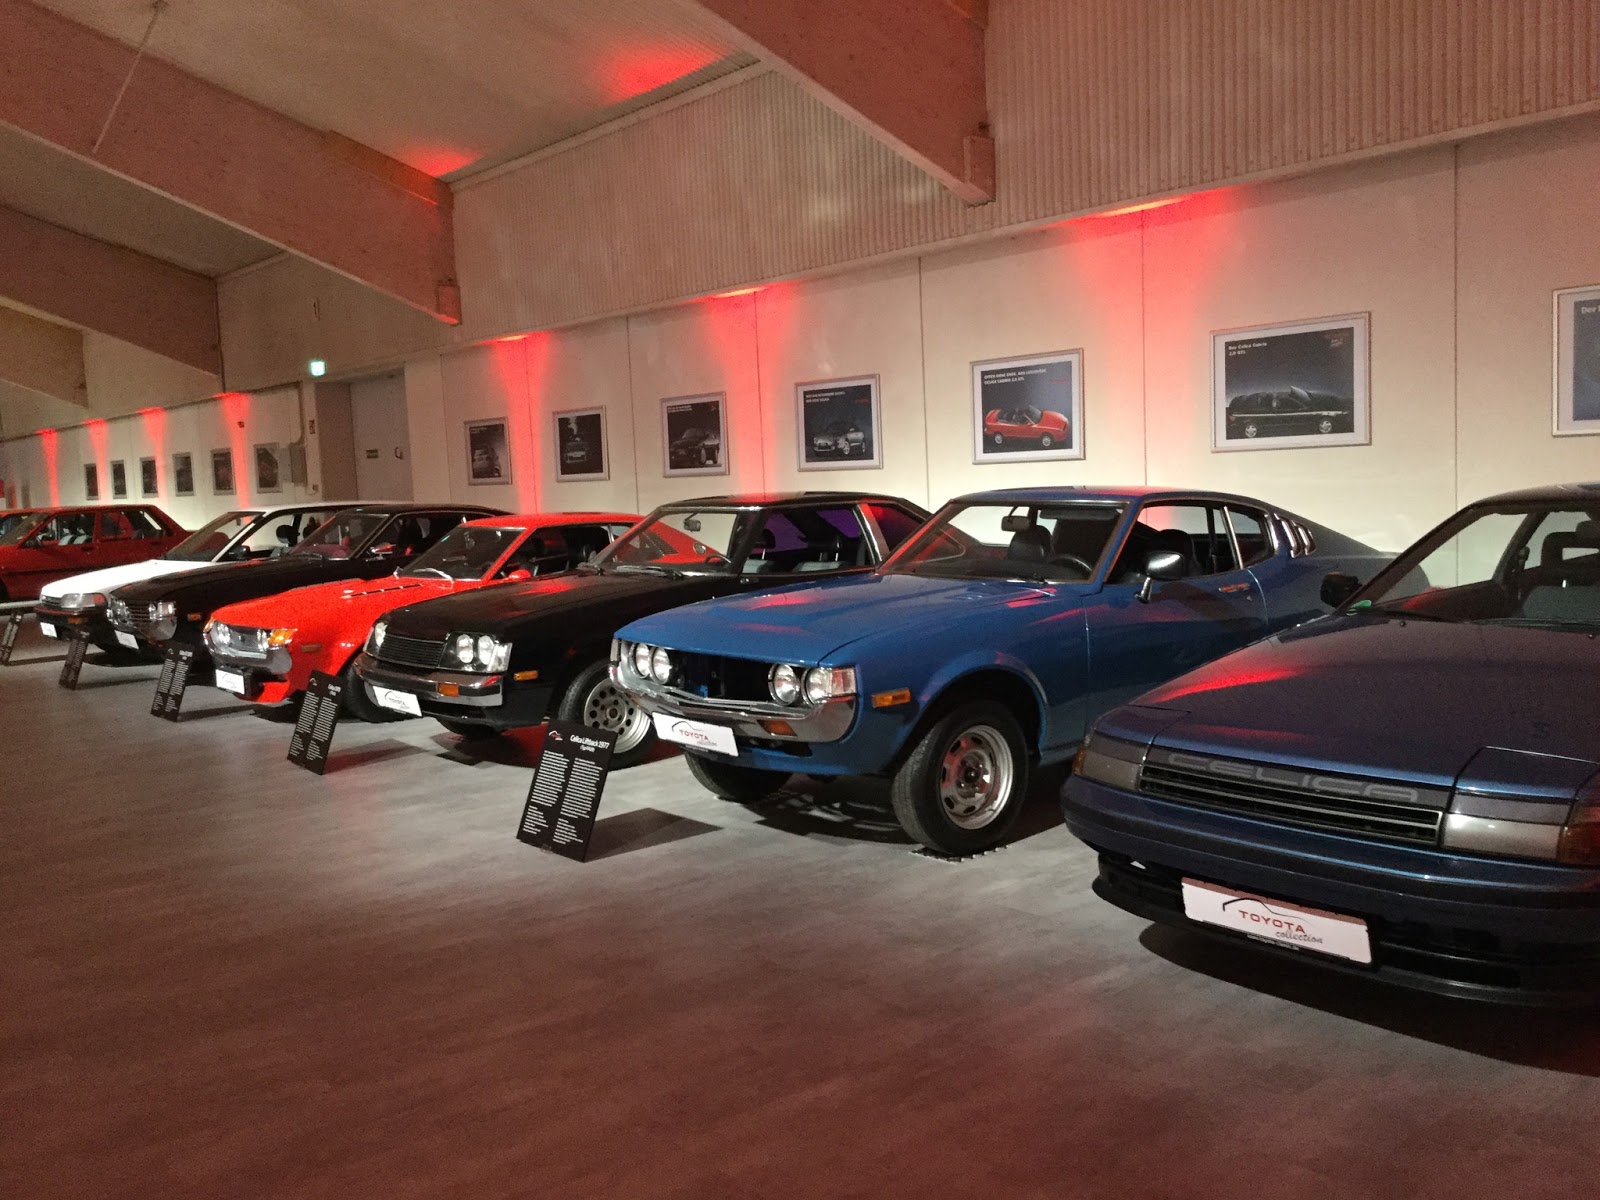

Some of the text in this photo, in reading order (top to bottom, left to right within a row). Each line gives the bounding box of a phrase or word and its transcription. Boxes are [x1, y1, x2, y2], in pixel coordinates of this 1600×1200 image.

[679, 729, 710, 742] TOYOTA
[1168, 753, 1418, 803] CELICA
[1238, 909, 1305, 934] TOYOTA
[1275, 929, 1323, 944] collection
